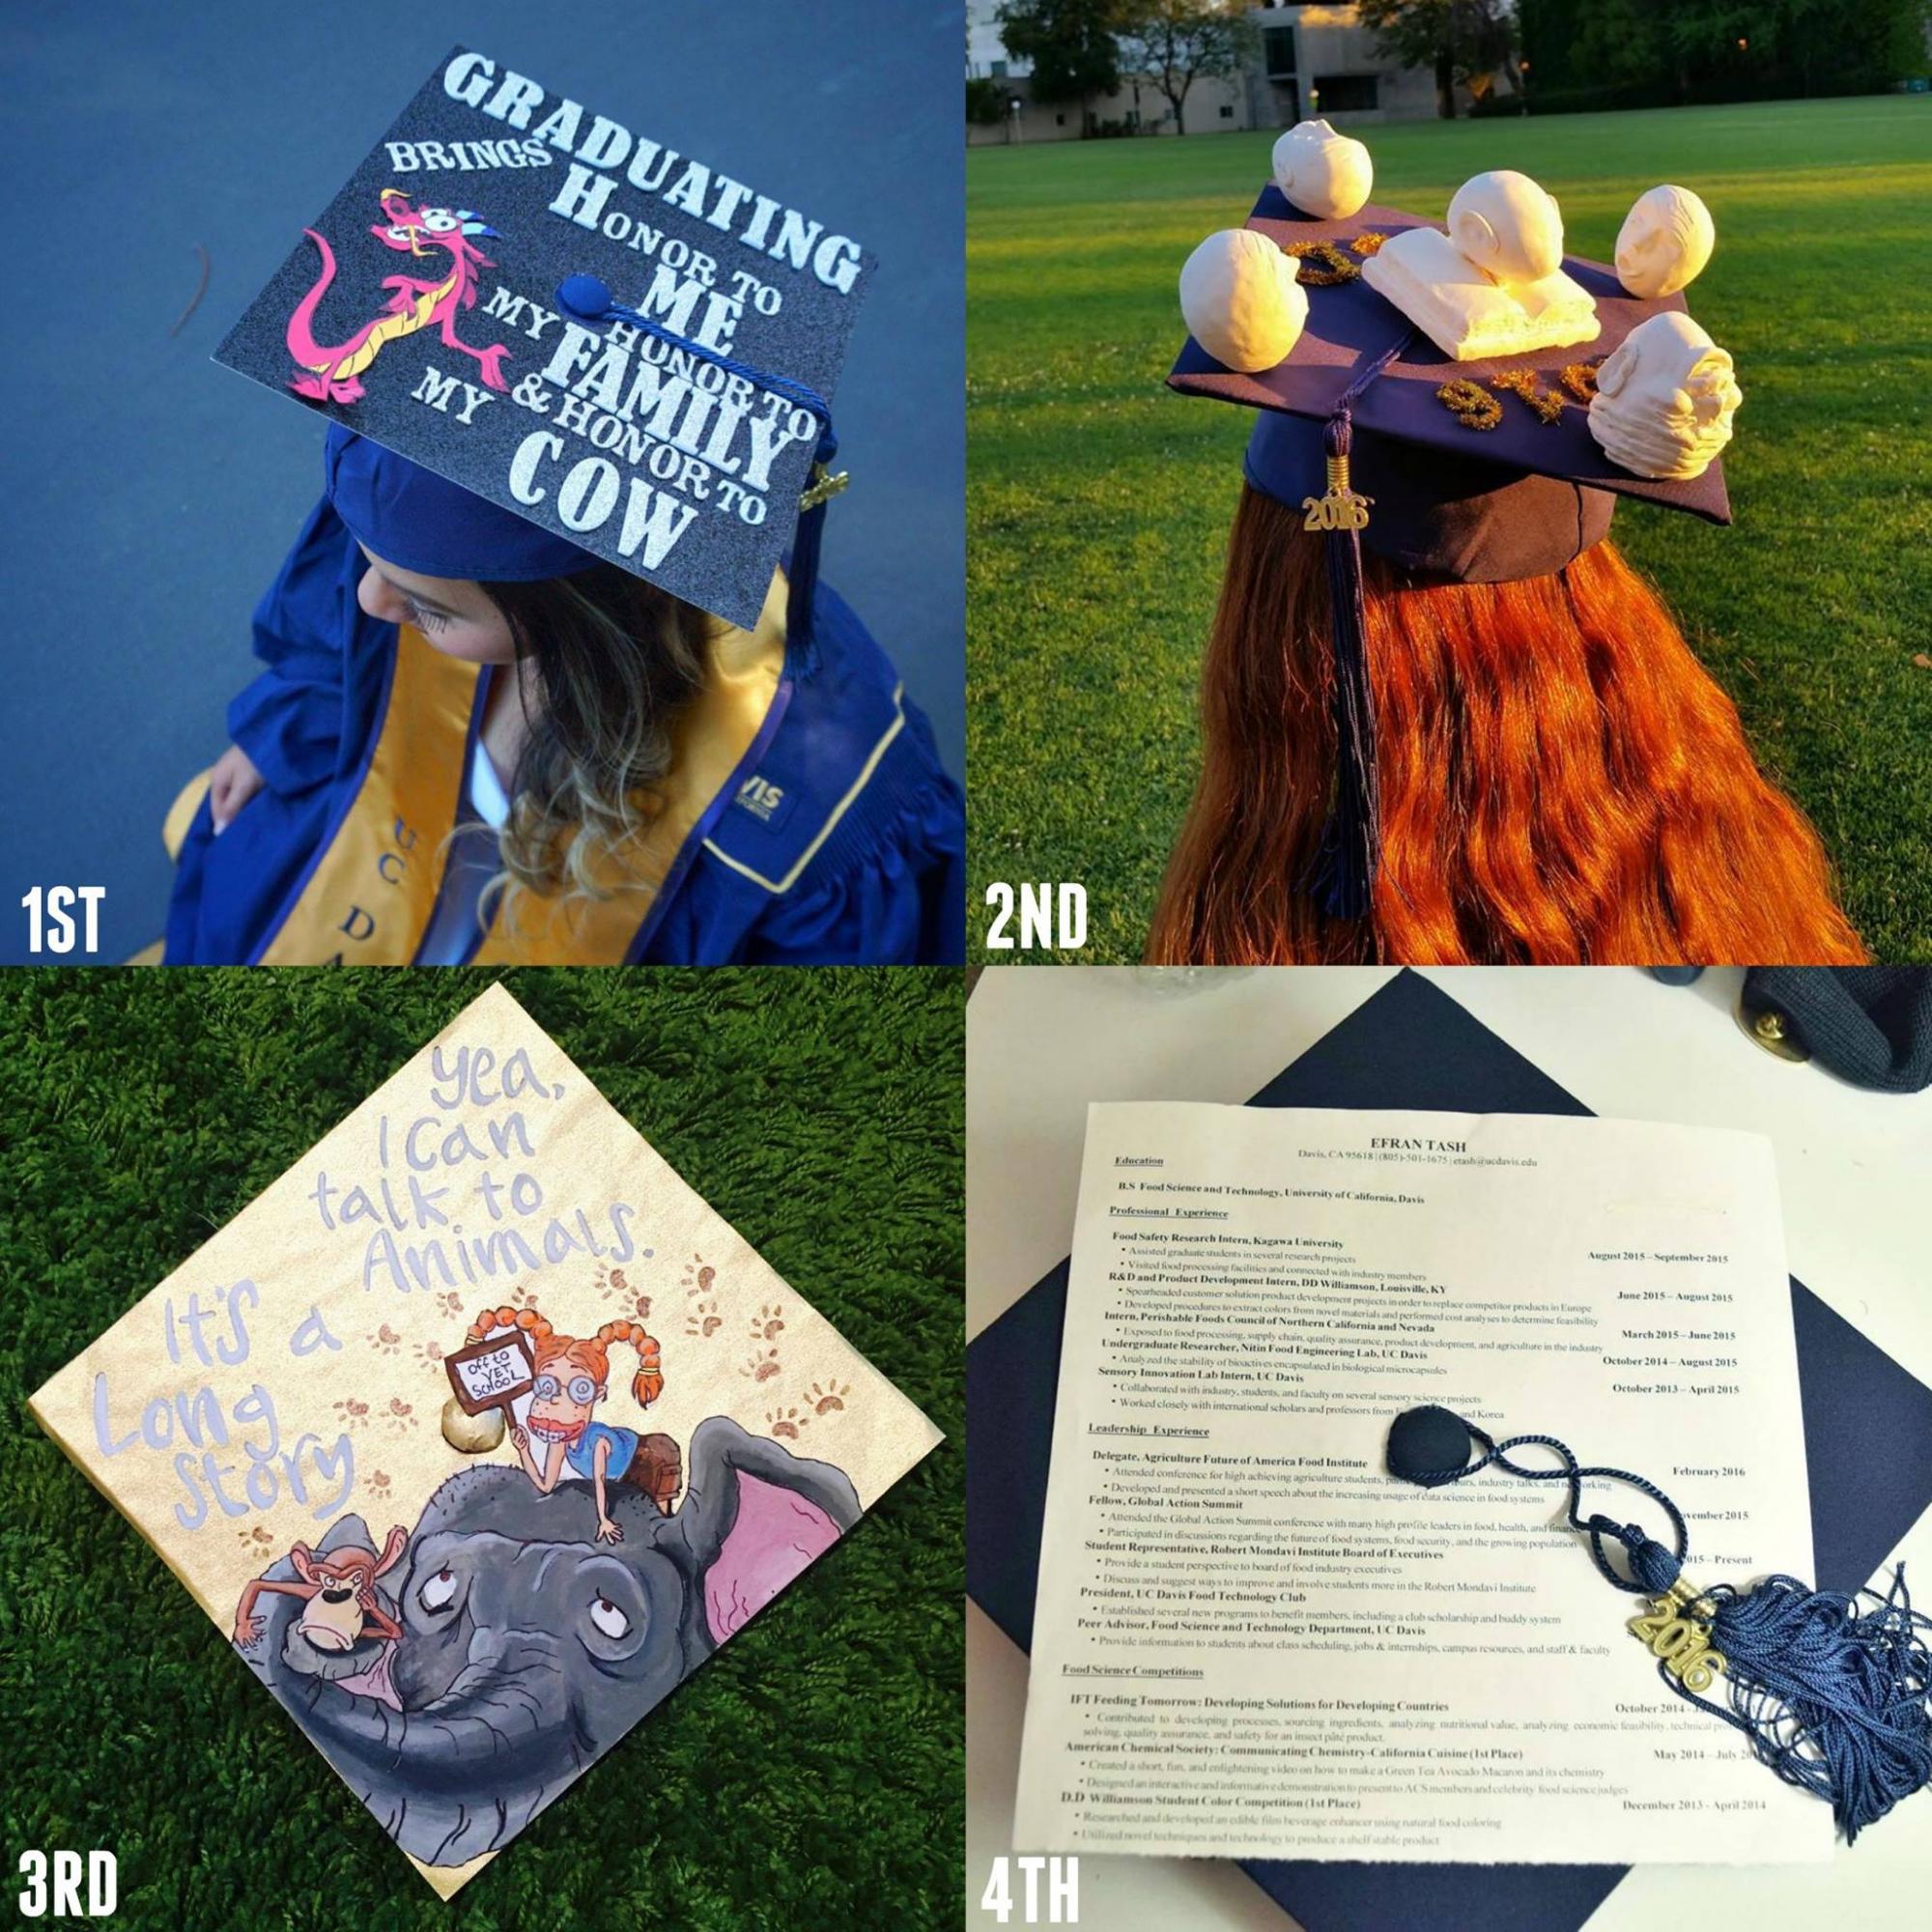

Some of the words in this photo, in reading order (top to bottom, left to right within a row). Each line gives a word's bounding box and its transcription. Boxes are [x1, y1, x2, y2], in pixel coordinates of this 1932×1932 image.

[384, 138, 553, 172] BRINGS
[443, 52, 862, 295] GRADUATING
[731, 270, 782, 316] TO
[482, 287, 560, 340] MY
[636, 264, 744, 356] ME
[605, 320, 754, 412] HONOR
[762, 391, 817, 441] TO
[541, 321, 797, 493] FAMILY
[410, 365, 496, 425] MY
[511, 372, 551, 413] &
[553, 392, 710, 501] HONOR
[717, 481, 768, 526] TO
[509, 430, 698, 572] COW
[1302, 496, 1370, 531] 2016
[1370, 1137, 1422, 1150] EFRAN
[1426, 1140, 1466, 1151] TASH
[1115, 1155, 1163, 1165] Education
[308, 1171, 450, 1231] talk
[472, 1170, 544, 1221] to
[1140, 1182, 1164, 1191] Food
[1166, 1183, 1202, 1192] Science
[1225, 1186, 1283, 1198] Technology,
[1285, 1189, 1332, 1200] University
[1347, 1191, 1397, 1203] California,
[1398, 1194, 1424, 1203] Davis
[1109, 1206, 1169, 1215] Professional
[1175, 1208, 1229, 1219] Experience
[1113, 1231, 1136, 1240] Food
[1139, 1232, 1169, 1243] Safety
[1171, 1233, 1215, 1242] Research
[1218, 1235, 1252, 1245] Intern,
[1253, 1236, 1293, 1247] Kagawa
[1294, 1237, 1343, 1249] University
[1589, 1251, 1621, 1261] August
[1623, 1251, 1645, 1260] 2015
[1654, 1252, 1706, 1263] September
[1139, 1272, 1156, 1281] and
[1159, 1272, 1199, 1283] Product
[1200, 1274, 1264, 1287] Development
[1265, 1277, 1299, 1288] Intern,
[1301, 1278, 1318, 1288] DD
[1320, 1279, 1378, 1292] Williamson,
[1381, 1282, 1429, 1293] Louisville,
[1430, 1284, 1445, 1293] KY
[1617, 1291, 1640, 1299] June
[1642, 1291, 1665, 1300] 2015
[1677, 1292, 1708, 1302] August
[1711, 1293, 1733, 1301] 2015
[1104, 1311, 1138, 1321] Intern,
[1140, 1312, 1192, 1321] Perishable
[1195, 1314, 1225, 1323] Foods
[1227, 1316, 1264, 1324] Council
[1265, 1317, 1277, 1325] of
[1279, 1318, 1323, 1327] Northern
[1326, 1320, 1376, 1329] California
[1378, 1321, 1397, 1330] and
[1399, 1321, 1435, 1331] Nevada
[290, 1305, 344, 1357] a
[1622, 1329, 1654, 1338] March
[1689, 1330, 1712, 1339] June
[1101, 1338, 1179, 1350] Undergraduate
[1180, 1341, 1238, 1352] Researcher,
[1241, 1344, 1266, 1352] Nitin
[1267, 1345, 1293, 1353] Food
[1295, 1346, 1354, 1357] Engineering
[1357, 1348, 1379, 1357] Lab,
[1401, 1349, 1428, 1358] Davis
[1603, 1356, 1642, 1365] October
[1644, 1356, 1667, 1365] 2014
[1679, 1357, 1712, 1367] August
[1714, 1357, 1737, 1366] 2015
[1097, 1366, 1136, 1378] Sensory
[1140, 1368, 1196, 1378] Innovation
[1198, 1370, 1218, 1378] Lab
[1220, 1371, 1254, 1381] Intern,
[1257, 1372, 1273, 1380] UC
[1275, 1373, 1304, 1381] Davis
[1654, 1384, 1677, 1393] 2013
[1689, 1384, 1714, 1395] April
[92, 1371, 280, 1462] Long
[1089, 1423, 1147, 1435] Leadership
[1153, 1425, 1209, 1437] Experience
[1093, 1450, 1140, 1462] Delegate,
[1144, 1452, 1202, 1463] Agriculture
[1204, 1454, 1238, 1463] Future
[1239, 1455, 1252, 1463] of
[1253, 1455, 1295, 1464] America
[1298, 1457, 1323, 1465] Food
[1325, 1457, 1368, 1467] Institute
[1673, 1466, 1719, 1477] February
[1721, 1466, 1745, 1475] 2016
[1088, 1495, 1126, 1506] Fellow,
[1128, 1496, 1163, 1505] Global
[1165, 1497, 1200, 1506] Action
[1202, 1498, 1242, 1508] Summit
[1084, 1541, 1126, 1550] Student
[1128, 1542, 1208, 1554] Representative,
[1209, 1545, 1246, 1553] Robert
[1248, 1546, 1296, 1554] Mondavi
[1298, 1547, 1341, 1555] Institute
[1343, 1548, 1375, 1556] Board
[1389, 1548, 1443, 1558] Executives
[1080, 1587, 1134, 1599] President,
[1136, 1589, 1153, 1598] UC
[1156, 1589, 1186, 1599] Davis
[1188, 1590, 1215, 1599] Food
[1217, 1591, 1276, 1603] Technology
[1279, 1592, 1306, 1602] Club
[1627, 1599, 1727, 1692] 2016
[1063, 1664, 1090, 1673] Food
[1092, 1664, 1131, 1674] Science
[1132, 1665, 1204, 1677] Competitions
[1070, 1694, 1093, 1703] IFT
[1094, 1694, 1136, 1706] Feeding
[1139, 1695, 1202, 1705] Tomorrow:
[1204, 1696, 1264, 1708] Developing
[1265, 1698, 1316, 1708] Solutions
[1318, 1699, 1333, 1708] for
[1336, 1699, 1395, 1711] Developing
[1397, 1700, 1449, 1710] Countries
[1615, 1704, 1658, 1713] October
[1660, 1704, 1684, 1713] 2014
